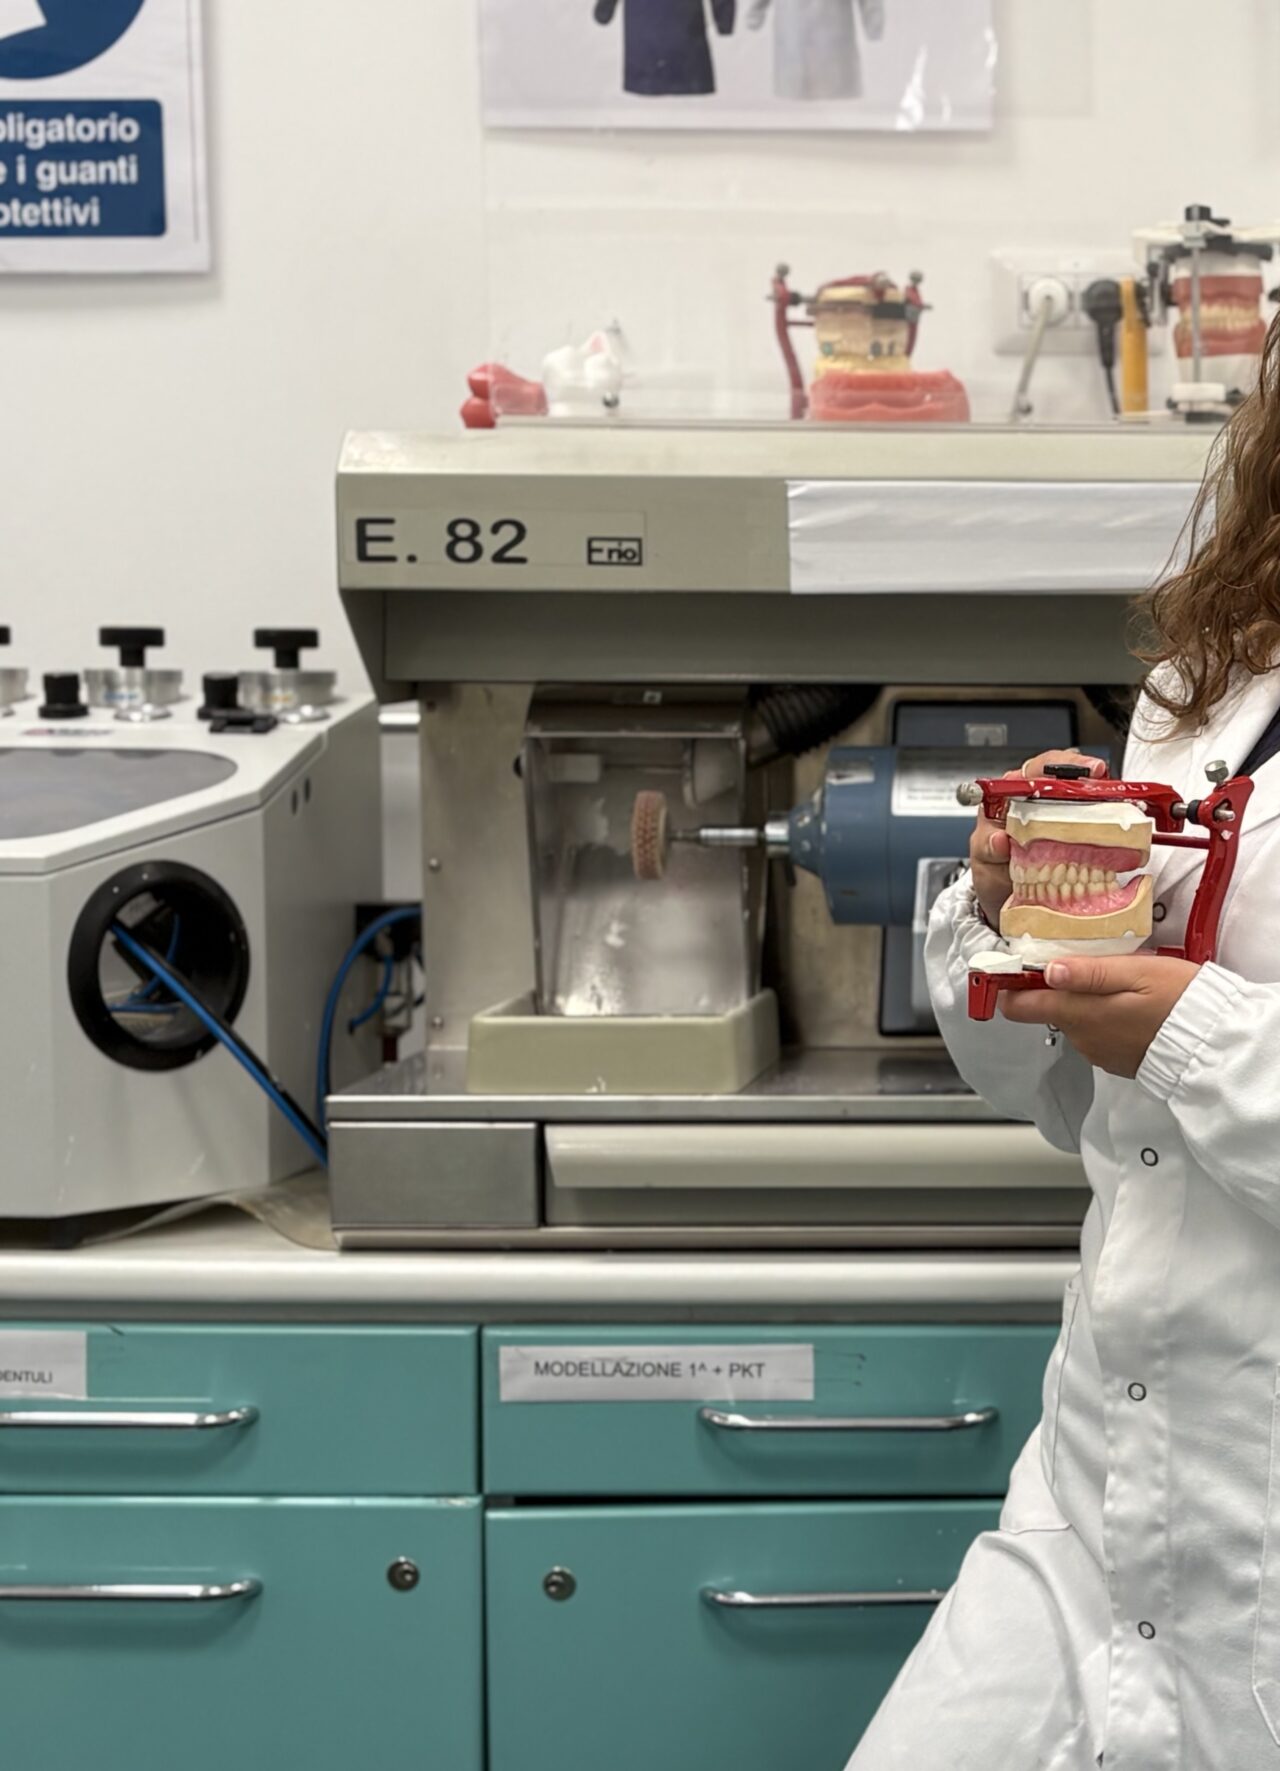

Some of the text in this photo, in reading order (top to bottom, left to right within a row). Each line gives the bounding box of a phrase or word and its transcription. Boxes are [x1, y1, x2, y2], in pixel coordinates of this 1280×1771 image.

[36, 154, 138, 192] guanti
[355, 517, 529, 564] E. 82
[533, 1361, 682, 1378] MODELLAZIONE
[729, 1362, 766, 1378] PKT
